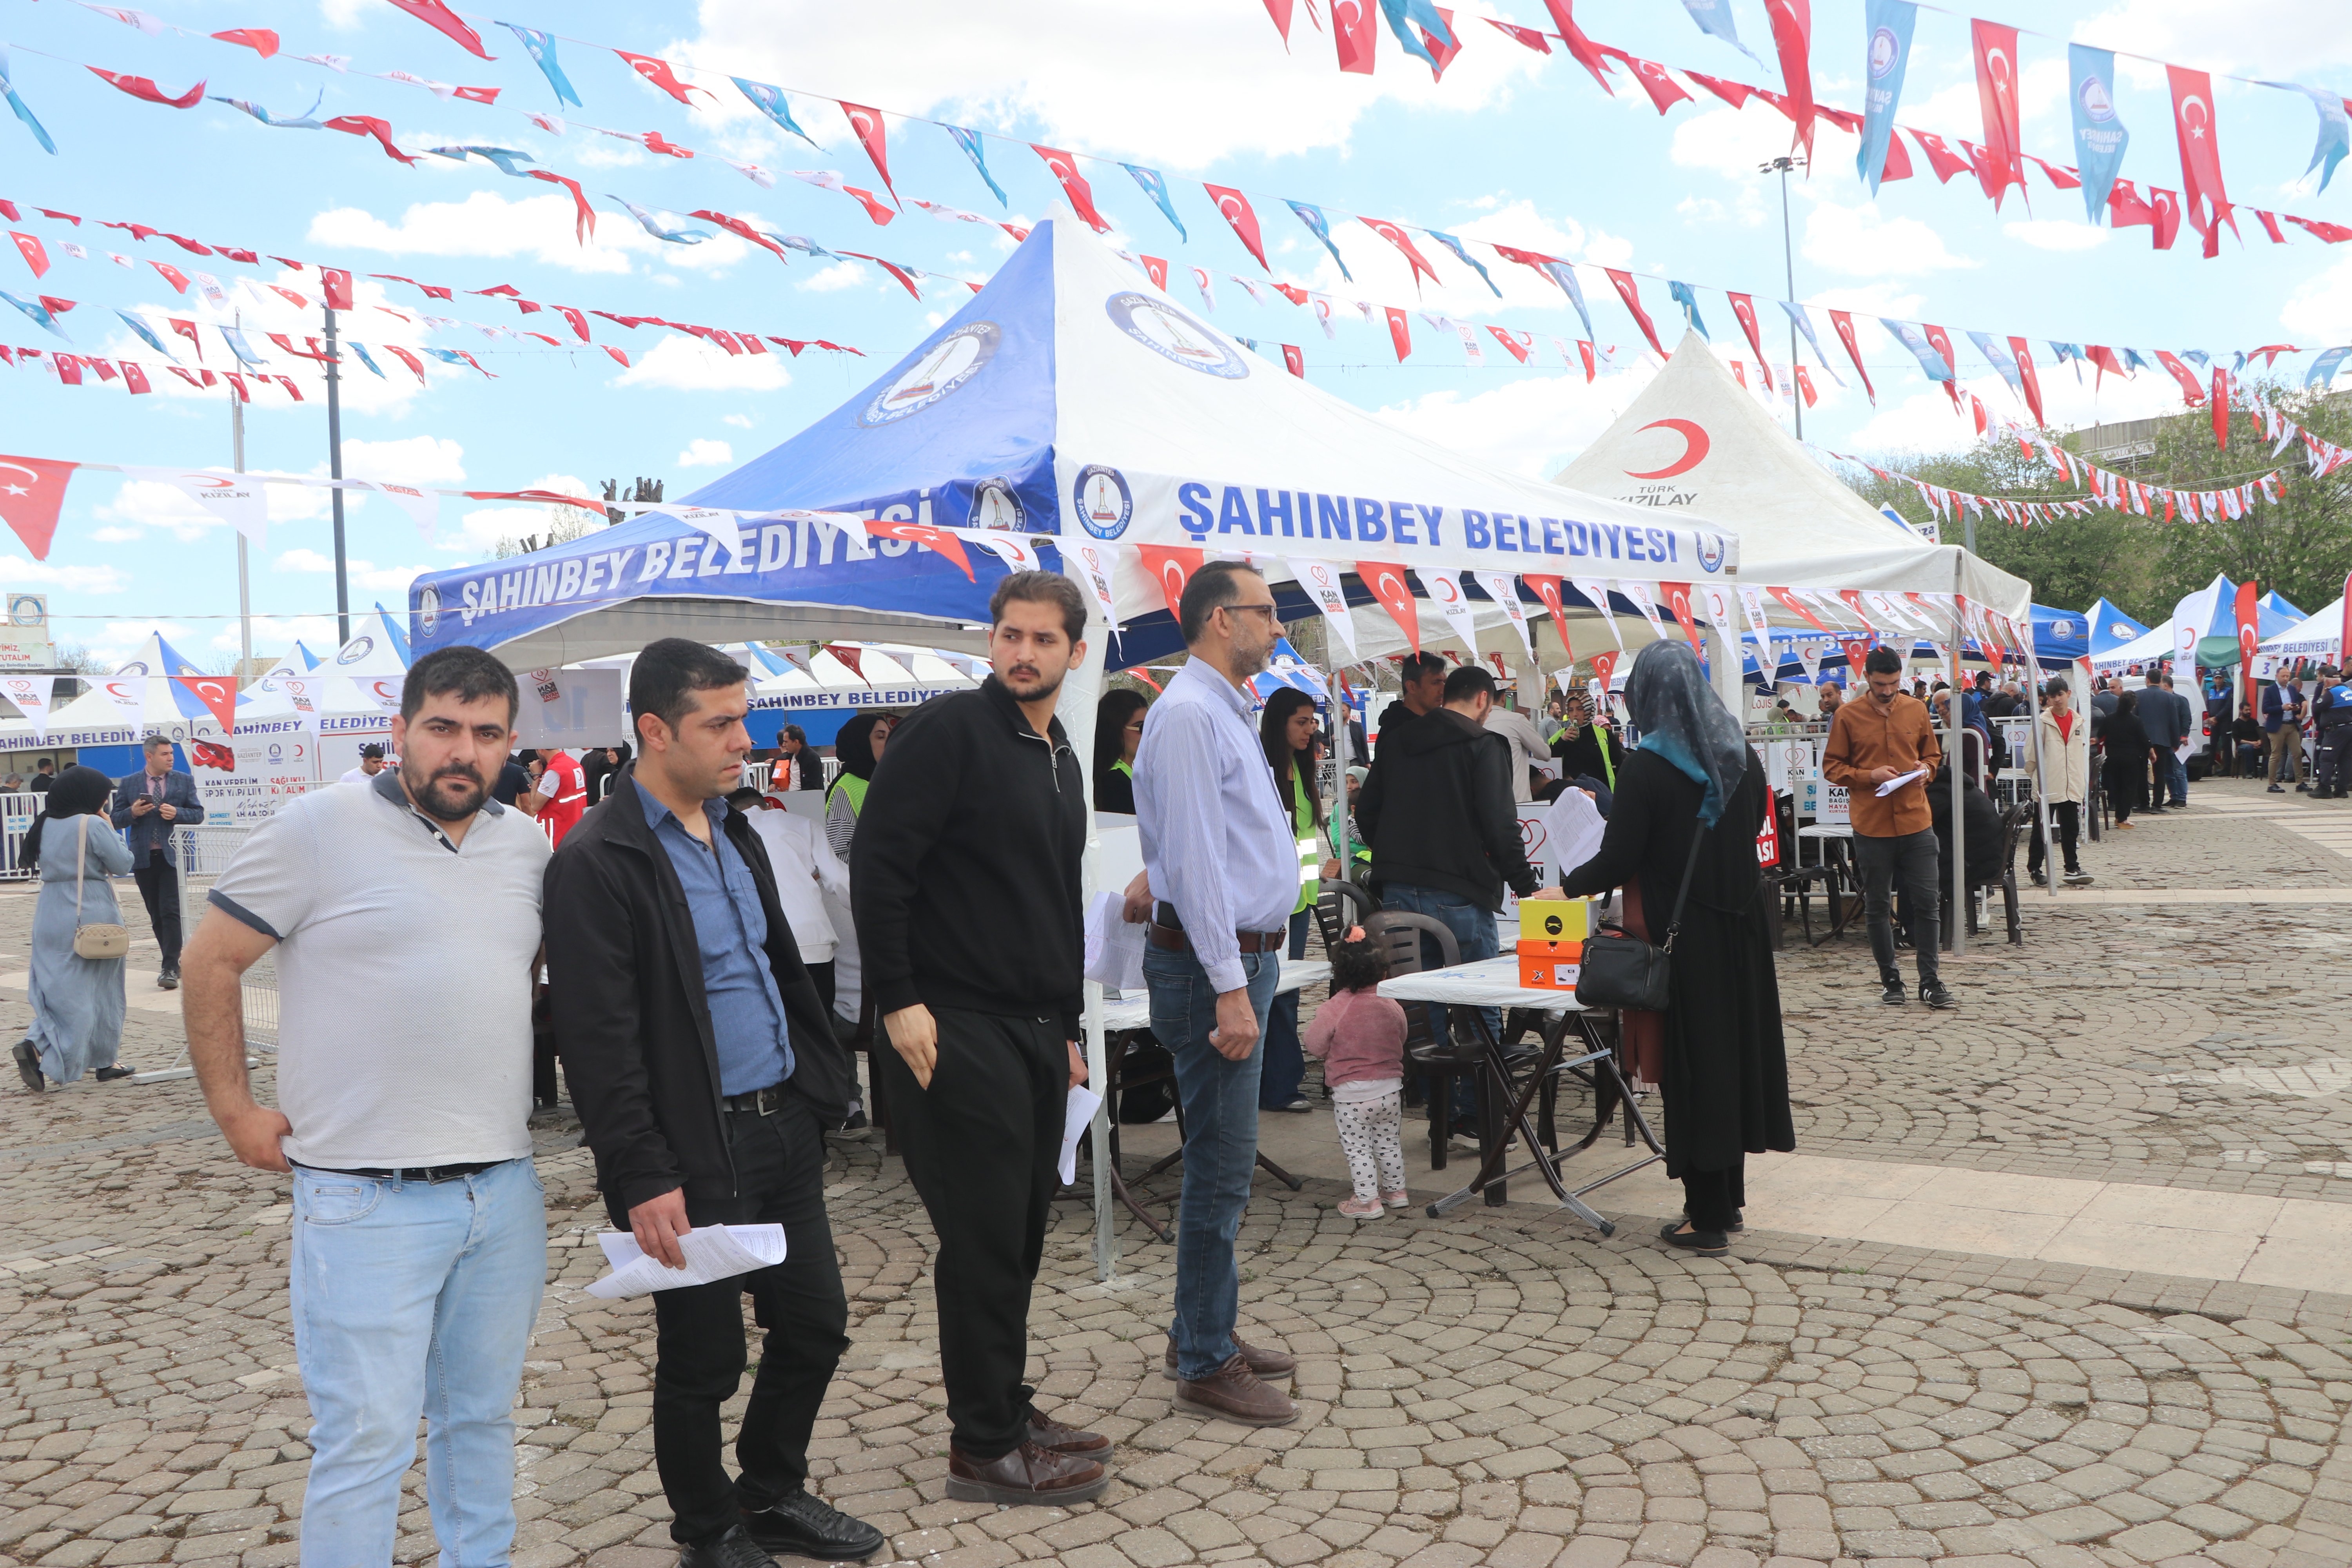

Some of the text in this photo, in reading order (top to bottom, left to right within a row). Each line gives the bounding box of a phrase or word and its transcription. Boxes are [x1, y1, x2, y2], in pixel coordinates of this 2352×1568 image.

[1087, 465, 1115, 477] GAZİANTEP
[1639, 485, 1677, 493] TÜRK
[1092, 574, 1107, 585] KAN
[461, 548, 636, 627] ŞAHİNBEY
[1319, 590, 1338, 599] KAN
[1503, 599, 1517, 608] KAN
[1445, 608, 1467, 616] KIZILAY
[2284, 641, 2328, 653] BELEDİYESİ
[2262, 662, 2270, 675] 3
